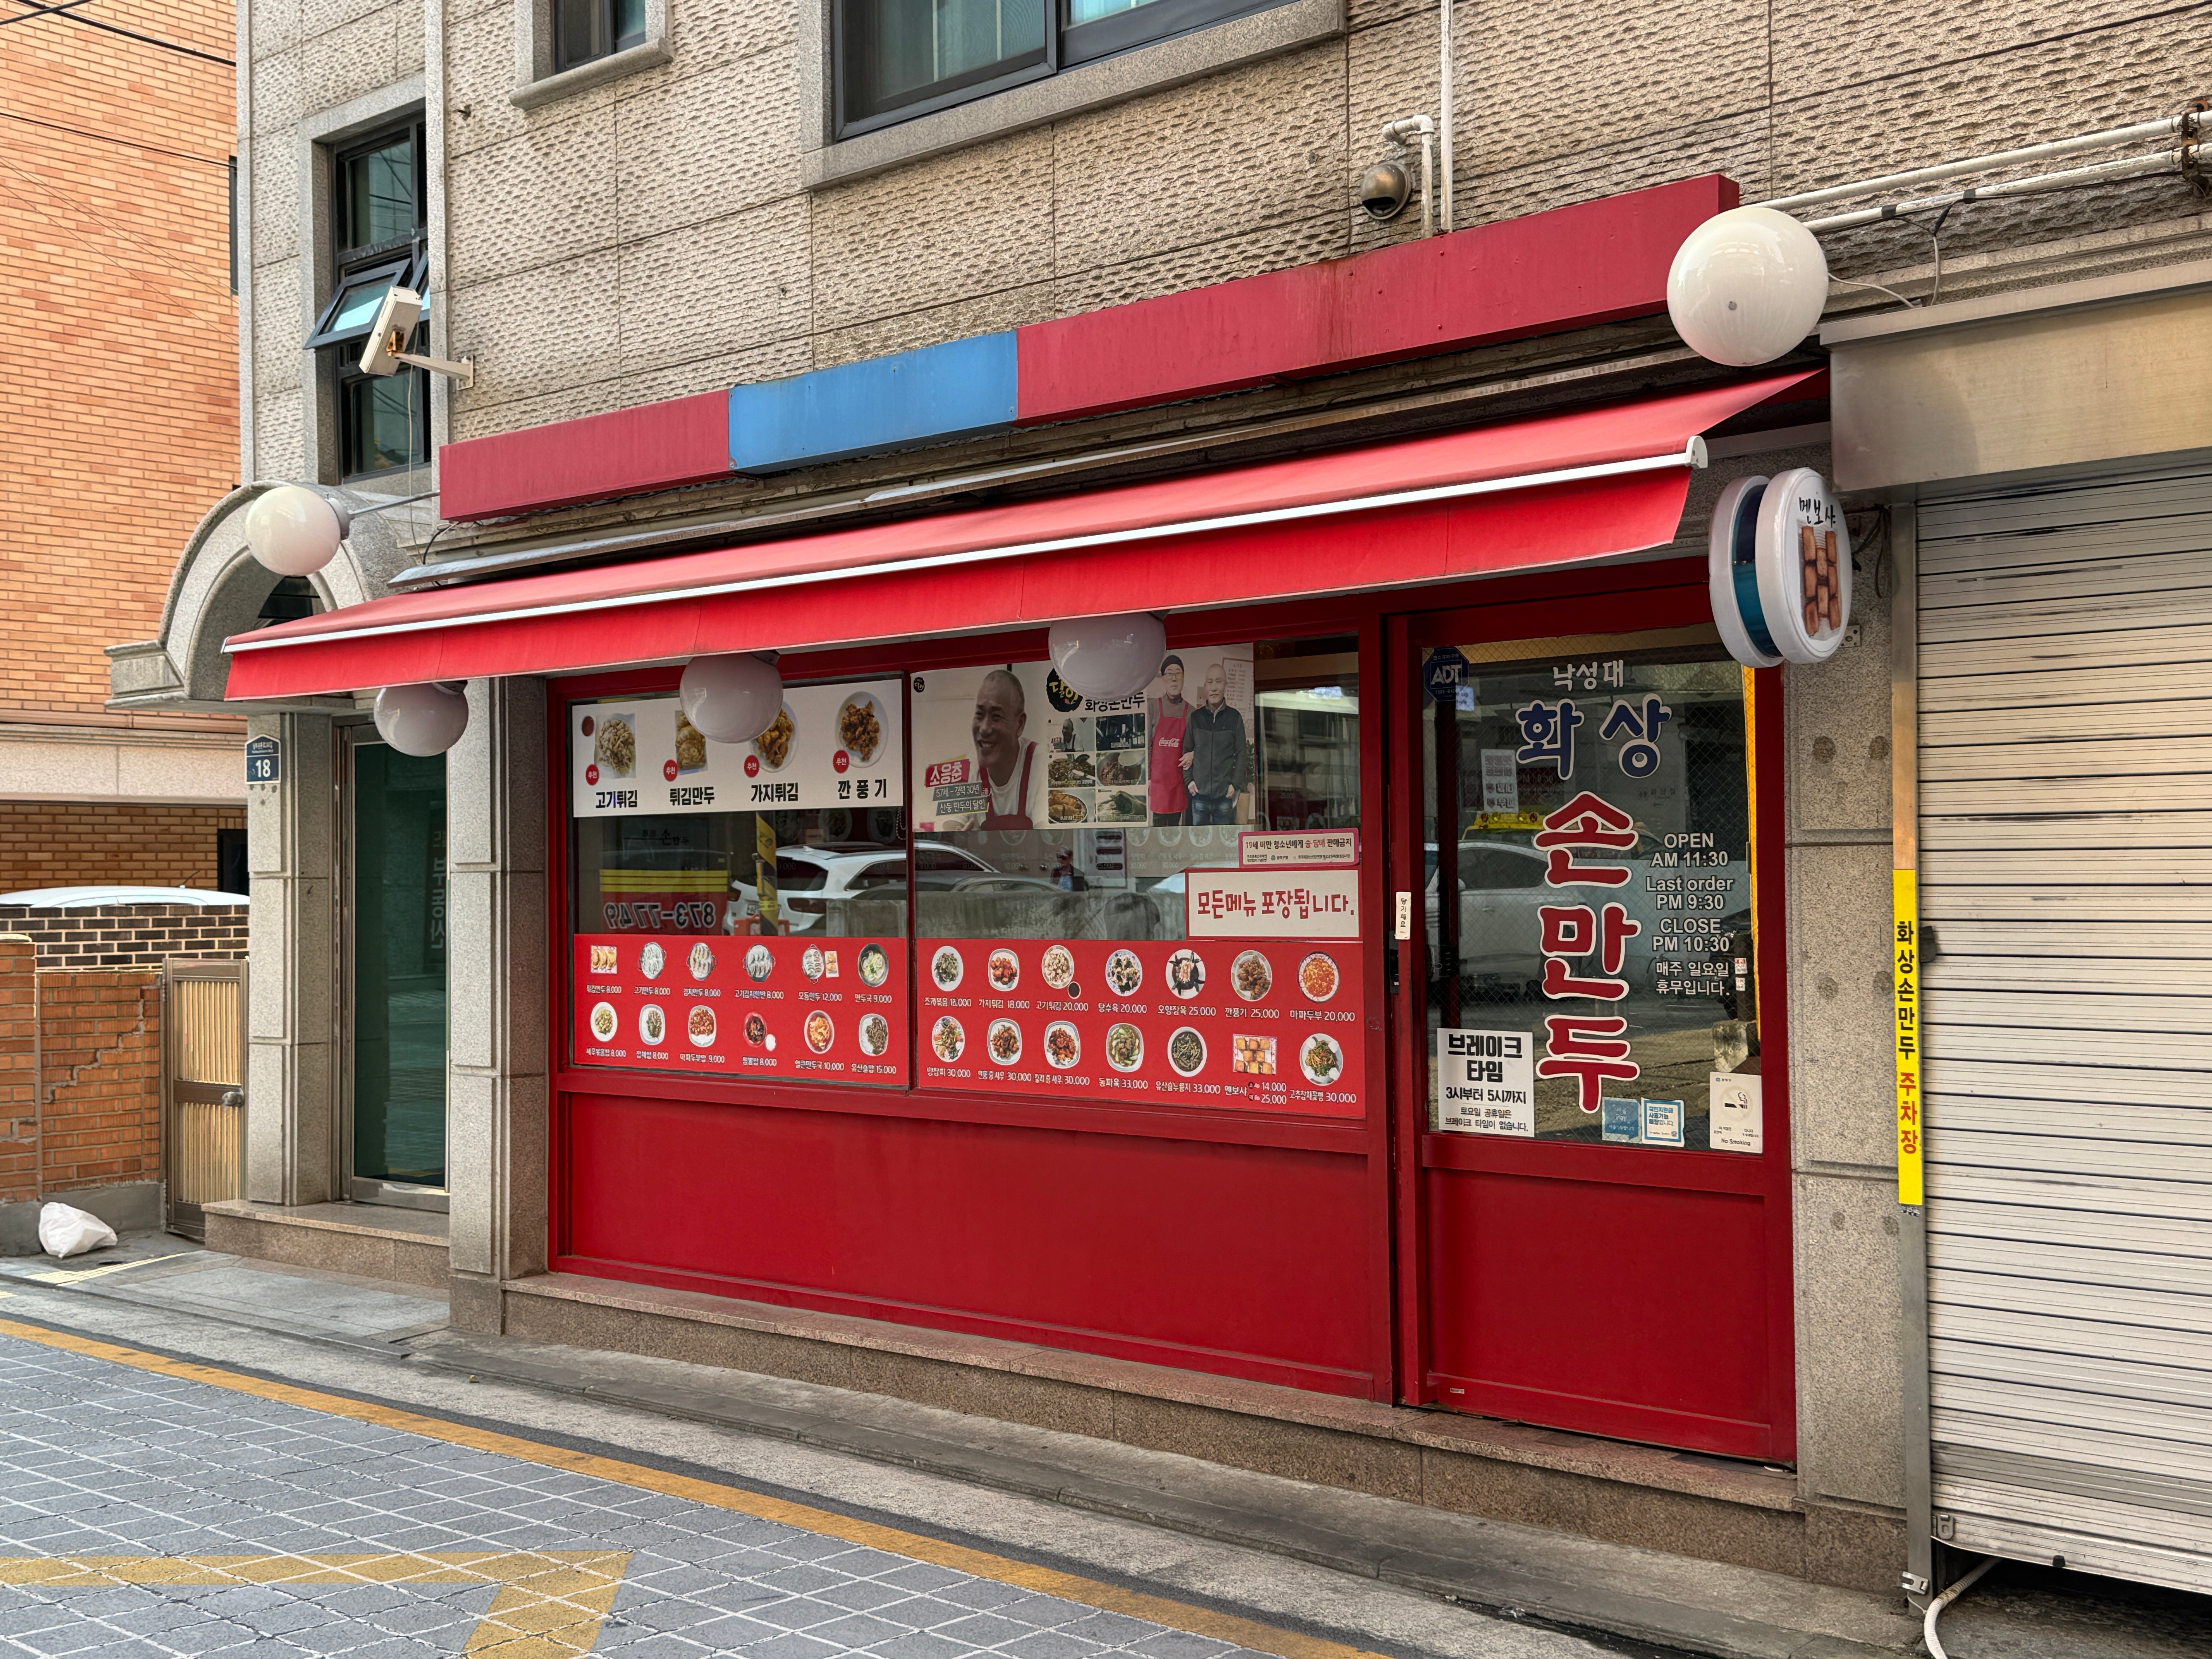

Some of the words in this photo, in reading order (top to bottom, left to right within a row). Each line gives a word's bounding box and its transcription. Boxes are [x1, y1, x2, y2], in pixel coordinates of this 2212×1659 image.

[1799, 496, 1836, 528] 멘보샤
[1431, 665, 1462, 685] ADT
[1553, 659, 1624, 691] 낙성대
[256, 759, 271, 778] 18
[747, 762, 757, 771] 추천
[835, 757, 846, 766] 추천
[587, 771, 598, 780] 추천
[666, 767, 676, 775] 추천
[929, 762, 962, 786] 소응춘
[670, 786, 715, 806] 튀김만두
[750, 782, 799, 803] 가지튀김
[936, 787, 949, 797] 57세
[955, 786, 965, 796] 경력
[967, 784, 979, 794] 30년
[595, 789, 638, 809] 고기튀김
[940, 803, 952, 813] 산둥
[953, 800, 971, 812] 만두의
[973, 799, 986, 810] 달인
[1246, 841, 1258, 849] 19세
[1260, 840, 1272, 849] 미만
[1274, 840, 1304, 849] 청소년에게
[1327, 838, 1352, 847] 판매금지
[1664, 833, 1714, 848] OPEN
[1650, 852, 1680, 868] AM
[1683, 852, 1728, 868] 11:30
[1646, 876, 1683, 893] Last
[1686, 876, 1734, 892] order
[1198, 890, 1256, 919] 모든메뉴
[1262, 888, 1354, 919] 포장됩니다.
[1656, 895, 1683, 911] PM
[1688, 894, 1724, 910] 9:30
[1660, 918, 1721, 934] CLOSE
[1533, 790, 1642, 1114] 손만두
[1653, 937, 1679, 952] PM
[1684, 936, 1729, 952] 10:30
[1656, 962, 1683, 977] 매주
[1688, 962, 1729, 977] 일요일
[634, 986, 654, 995] 고기만두
[1656, 979, 1730, 996] 휴무입니다.
[1896, 921, 1915, 1060] 화상손만두
[855, 994, 872, 1003] 만두국
[979, 999, 1003, 1009] 가지튀김
[1036, 1001, 1061, 1011] 고기튀김
[1098, 1003, 1118, 1013] 탕수육
[1225, 1007, 1247, 1018] 깐풍기
[1290, 1010, 1322, 1021] 마파두부
[1448, 1034, 1523, 1058] 브레이크
[1467, 1060, 1503, 1083] 타임
[1099, 1078, 1119, 1088] 동파육
[1224, 1085, 1247, 1096] 멘보샤
[1446, 1086, 1483, 1101] 3시부터
[1488, 1090, 1526, 1104] 5시까지
[1460, 1107, 1481, 1117] 토요일
[1484, 1108, 1512, 1119] 공휴일은
[1899, 1072, 1918, 1154] 주차장
[1445, 1117, 1472, 1127] 브레이크
[1475, 1119, 1496, 1129] 타임이
[1499, 1121, 1528, 1132] 없습니다.
